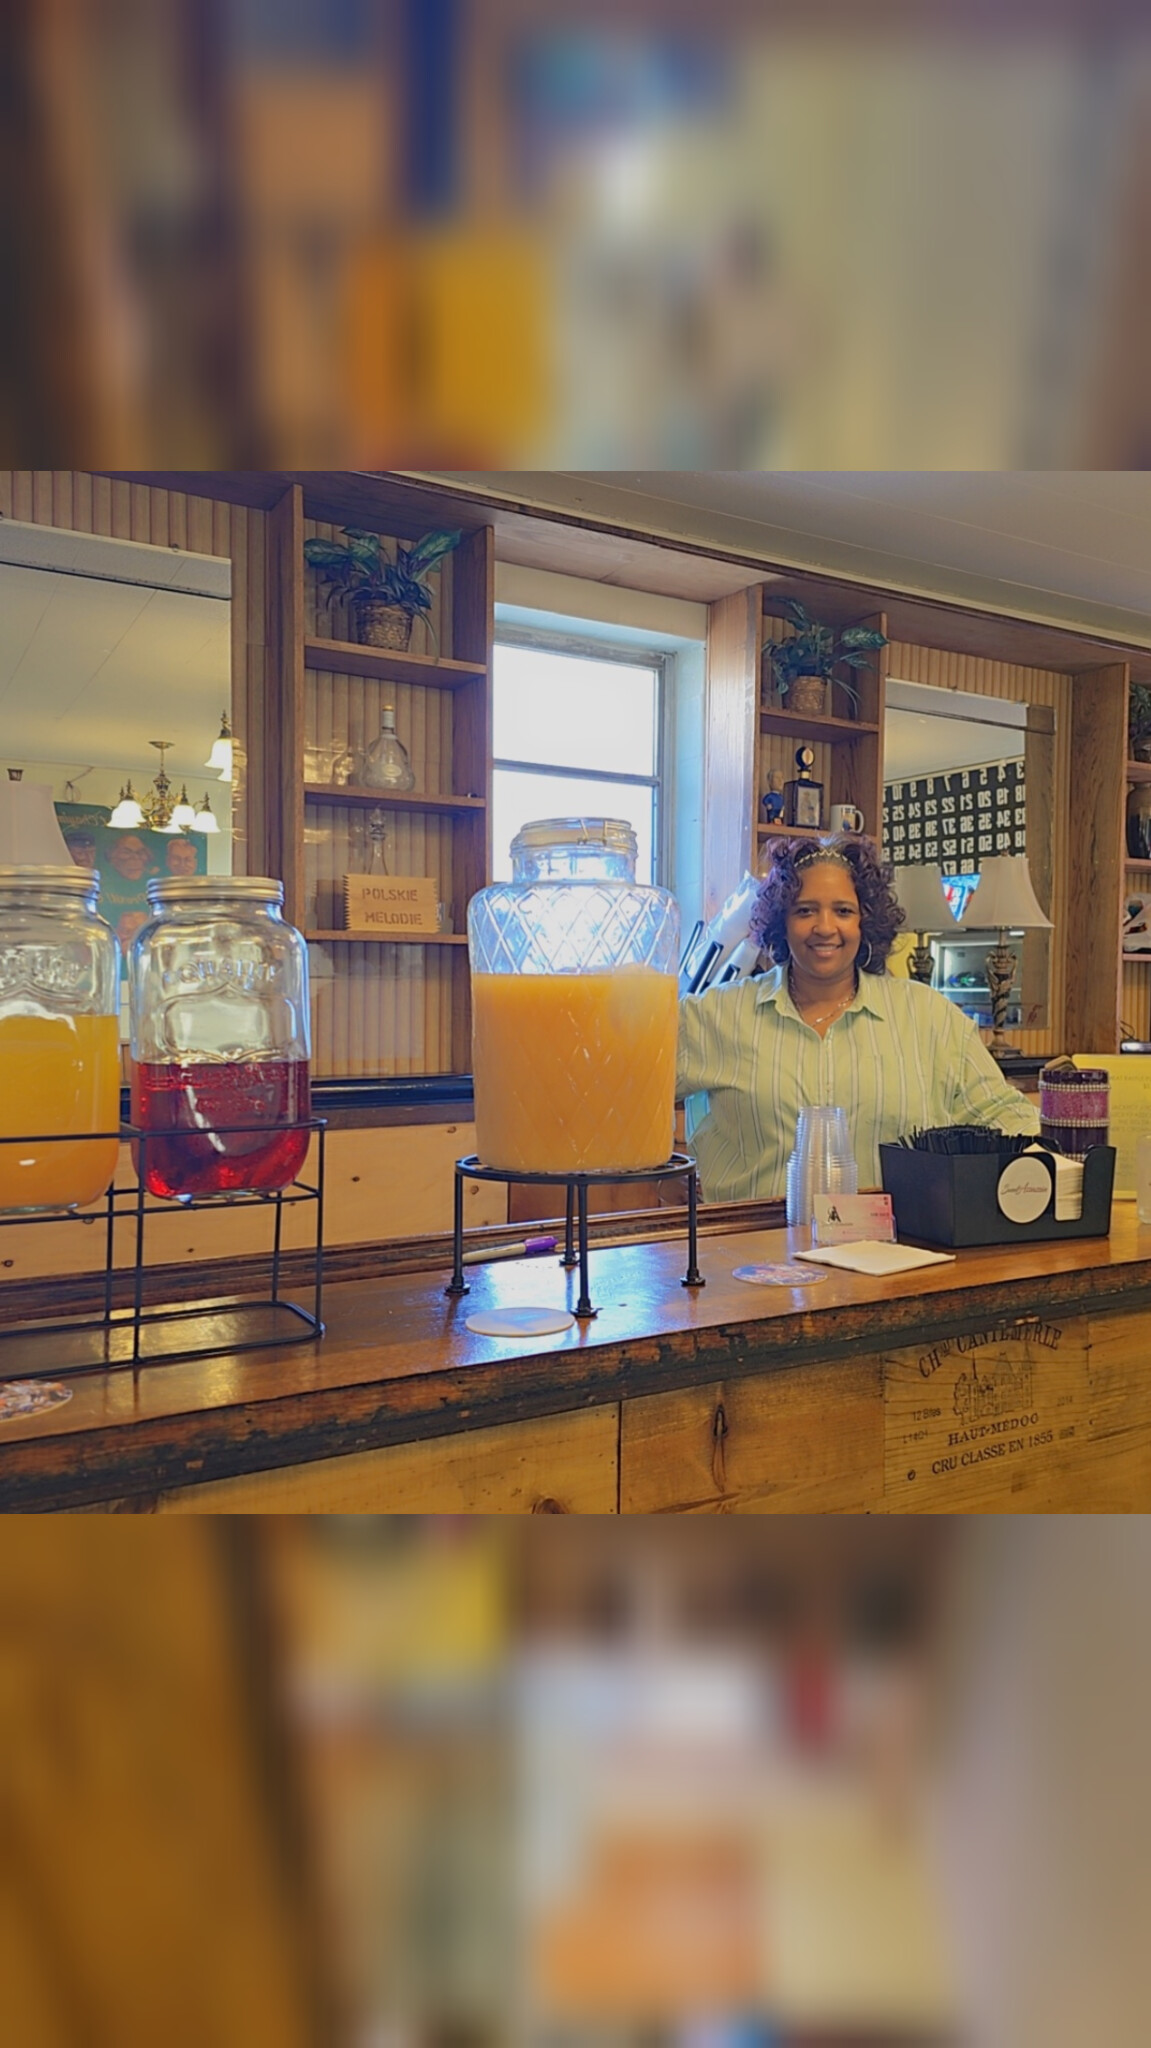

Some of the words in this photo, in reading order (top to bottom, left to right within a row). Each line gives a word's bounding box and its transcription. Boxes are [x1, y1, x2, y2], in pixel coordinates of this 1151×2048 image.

[361, 888, 419, 902] POLSKIE
[364, 911, 423, 926] MELODIE
[931, 1456, 958, 1475] CRU
[1009, 1437, 1025, 1454] EN
[1027, 1429, 1054, 1449] 1855
